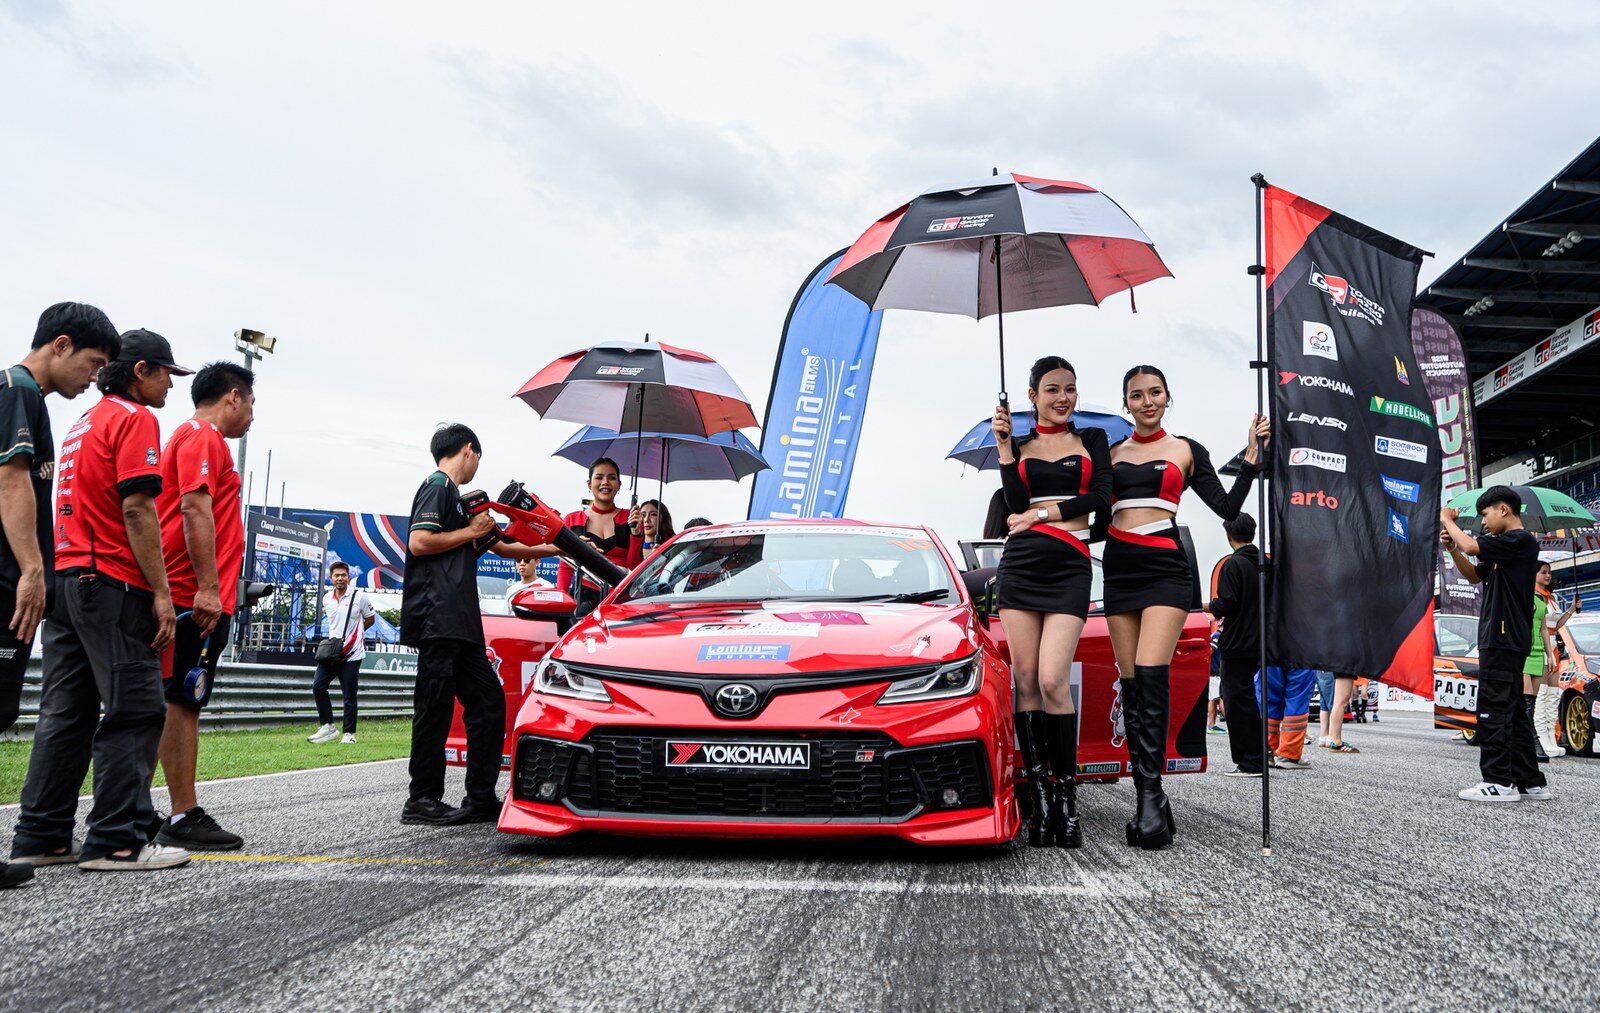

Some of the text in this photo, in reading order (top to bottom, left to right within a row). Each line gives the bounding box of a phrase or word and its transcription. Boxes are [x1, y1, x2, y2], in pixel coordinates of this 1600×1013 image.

[962, 213, 994, 221] TOYOTA
[927, 219, 960, 232] GR
[1310, 270, 1347, 304] GR
[1552, 329, 1571, 343] TOYOTA
[1287, 411, 1348, 432] LENSO
[1311, 453, 1345, 465] COMPACT
[1290, 490, 1339, 510] arto
[261, 519, 275, 533] Chang
[702, 745, 806, 764] YOKOHAMA
